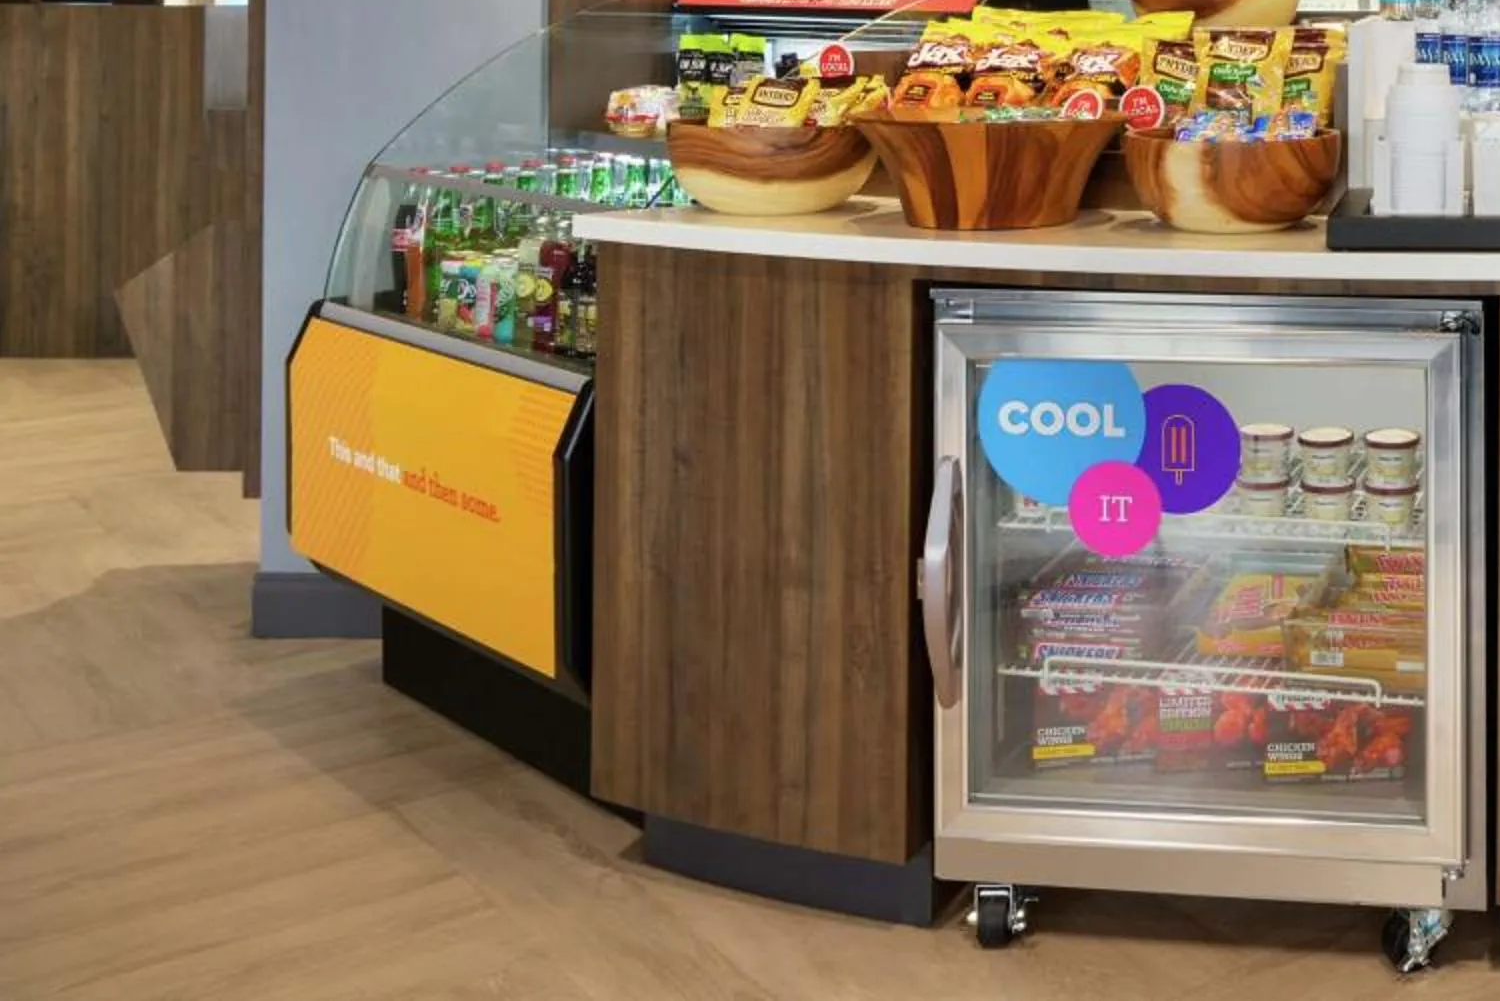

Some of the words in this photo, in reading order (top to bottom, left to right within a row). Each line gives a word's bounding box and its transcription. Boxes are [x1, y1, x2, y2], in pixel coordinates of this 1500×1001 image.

[999, 400, 1126, 438] COOL
[328, 435, 351, 464] This
[353, 450, 376, 475] and
[376, 454, 401, 485] that
[402, 466, 427, 495] and
[428, 470, 458, 508] then
[1097, 494, 1134, 523] IT
[1267, 742, 1315, 752] CHICKEN
